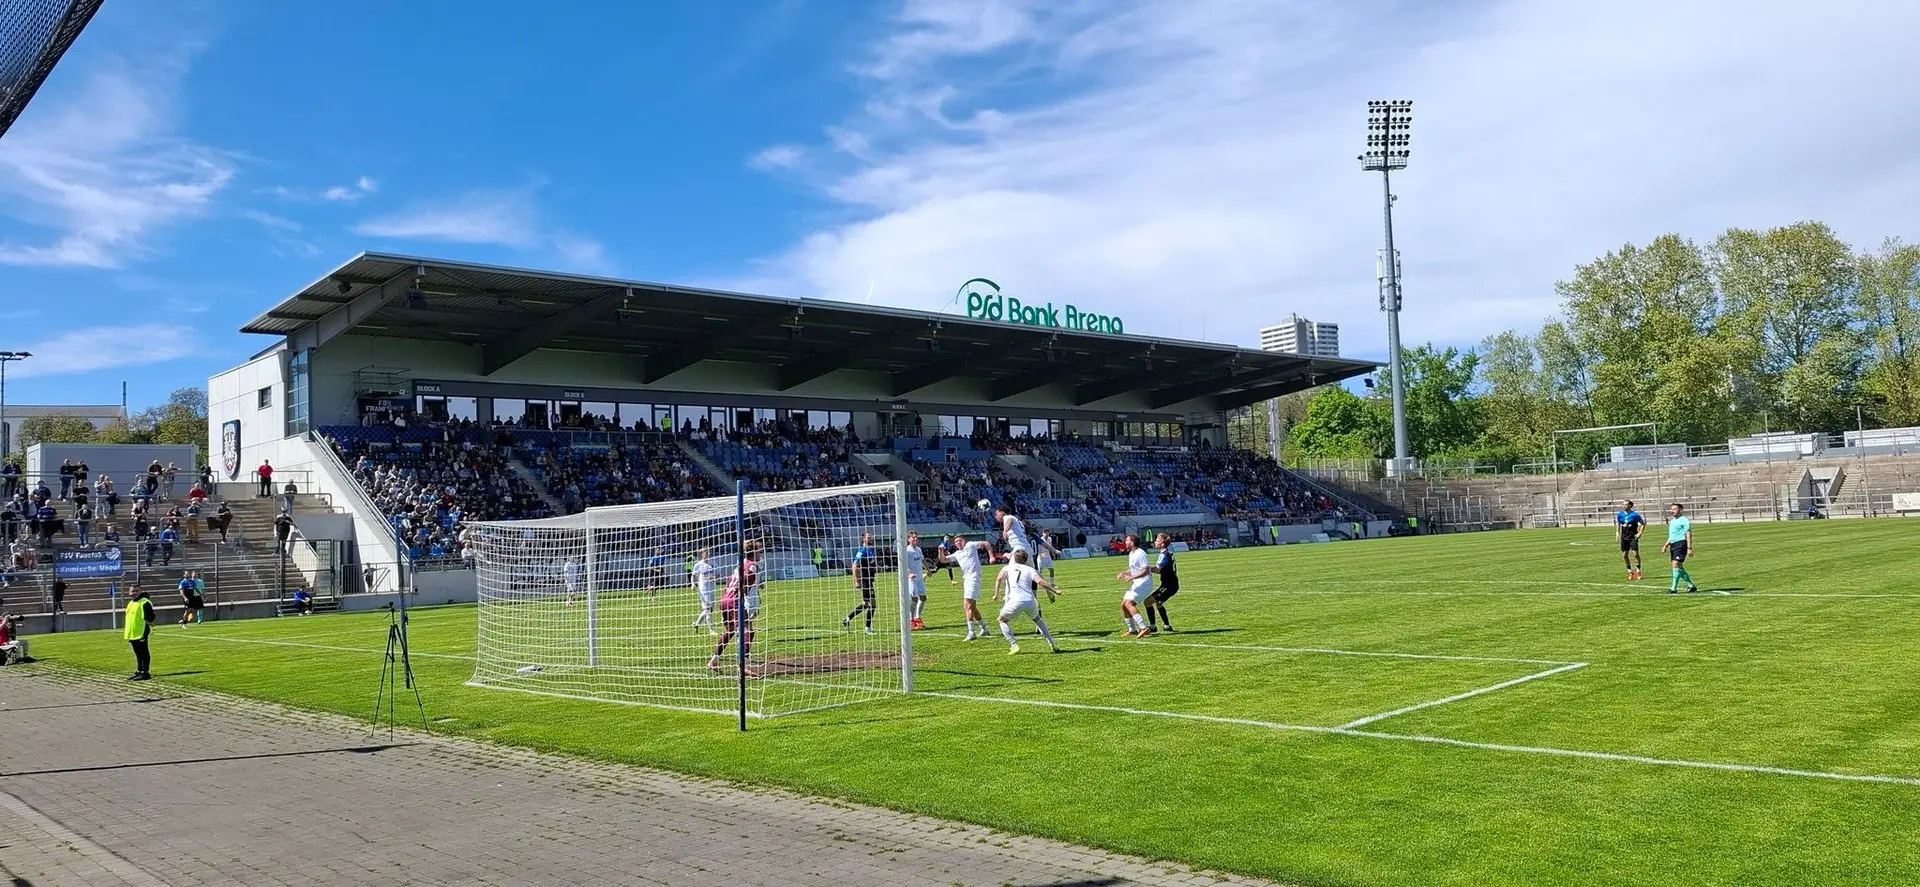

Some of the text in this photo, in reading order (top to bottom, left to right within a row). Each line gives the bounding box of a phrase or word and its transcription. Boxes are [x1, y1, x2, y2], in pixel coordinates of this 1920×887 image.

[1008, 297, 1061, 328] Bank
[1066, 304, 1124, 335] Arena
[417, 385, 436, 393] BLOCK
[60, 565, 97, 573] Komische
[1014, 568, 1021, 583] 7
